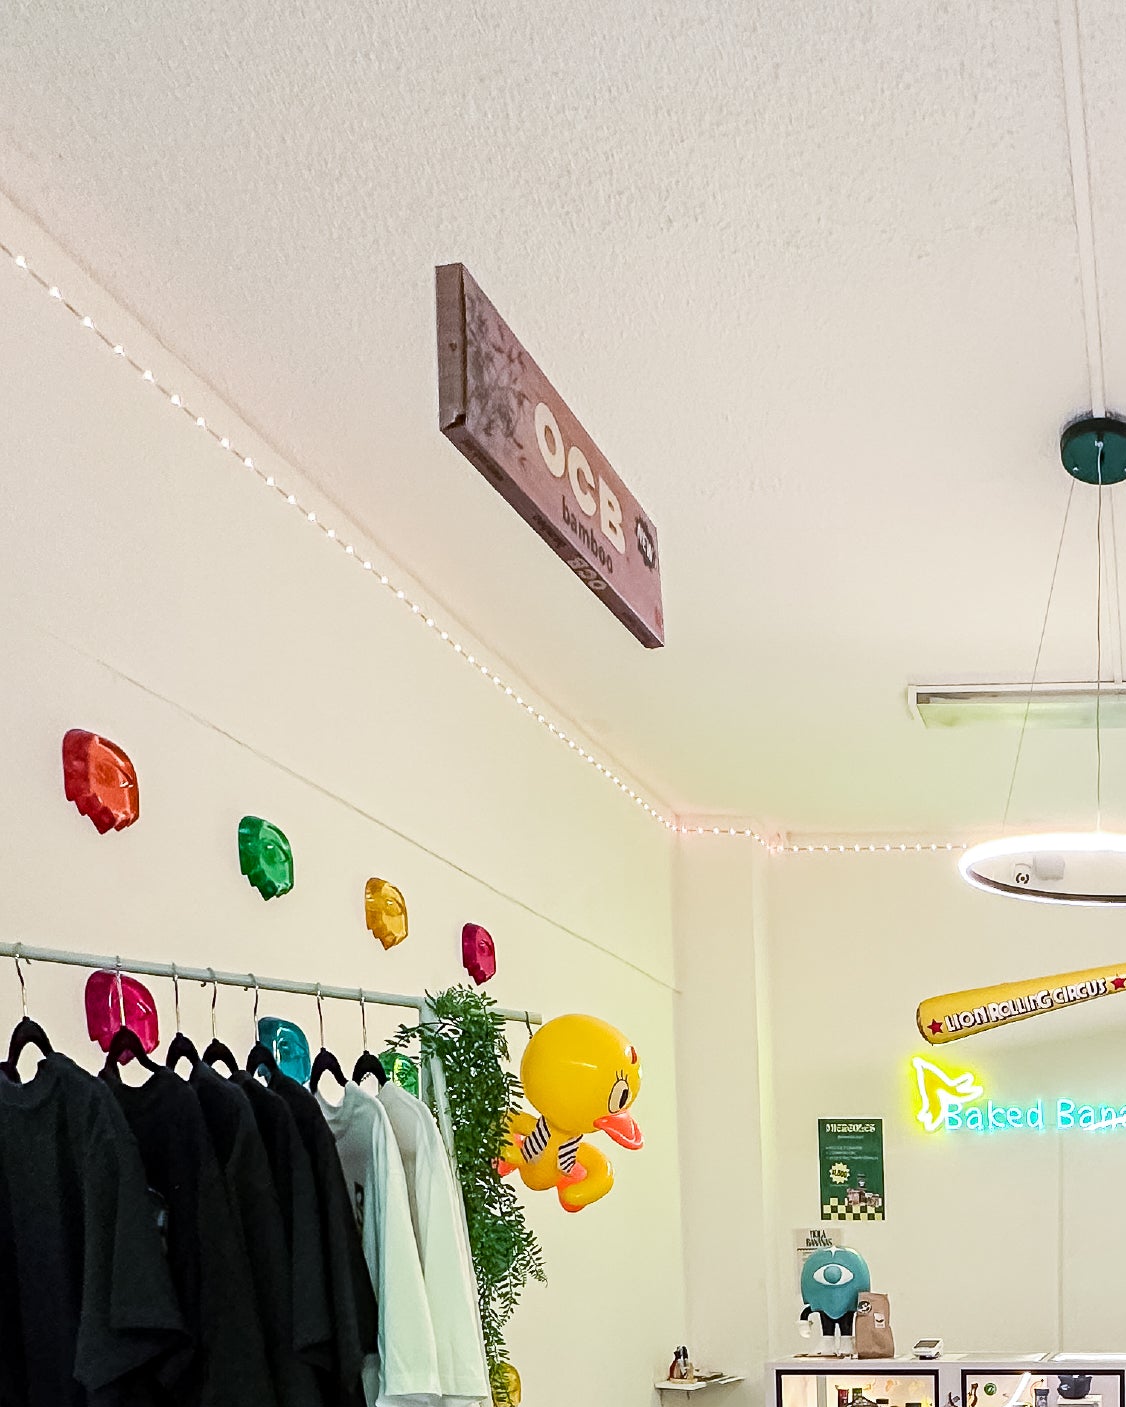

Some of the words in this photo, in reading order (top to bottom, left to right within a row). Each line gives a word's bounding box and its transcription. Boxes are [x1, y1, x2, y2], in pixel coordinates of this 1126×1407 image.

[534, 402, 626, 555] OCB
[562, 495, 613, 574] bamboo
[944, 1006, 990, 1032] LION
[990, 991, 1053, 1023] ROLLING
[1052, 978, 1107, 1005] CIRCUS
[944, 1099, 1044, 1131] Baked
